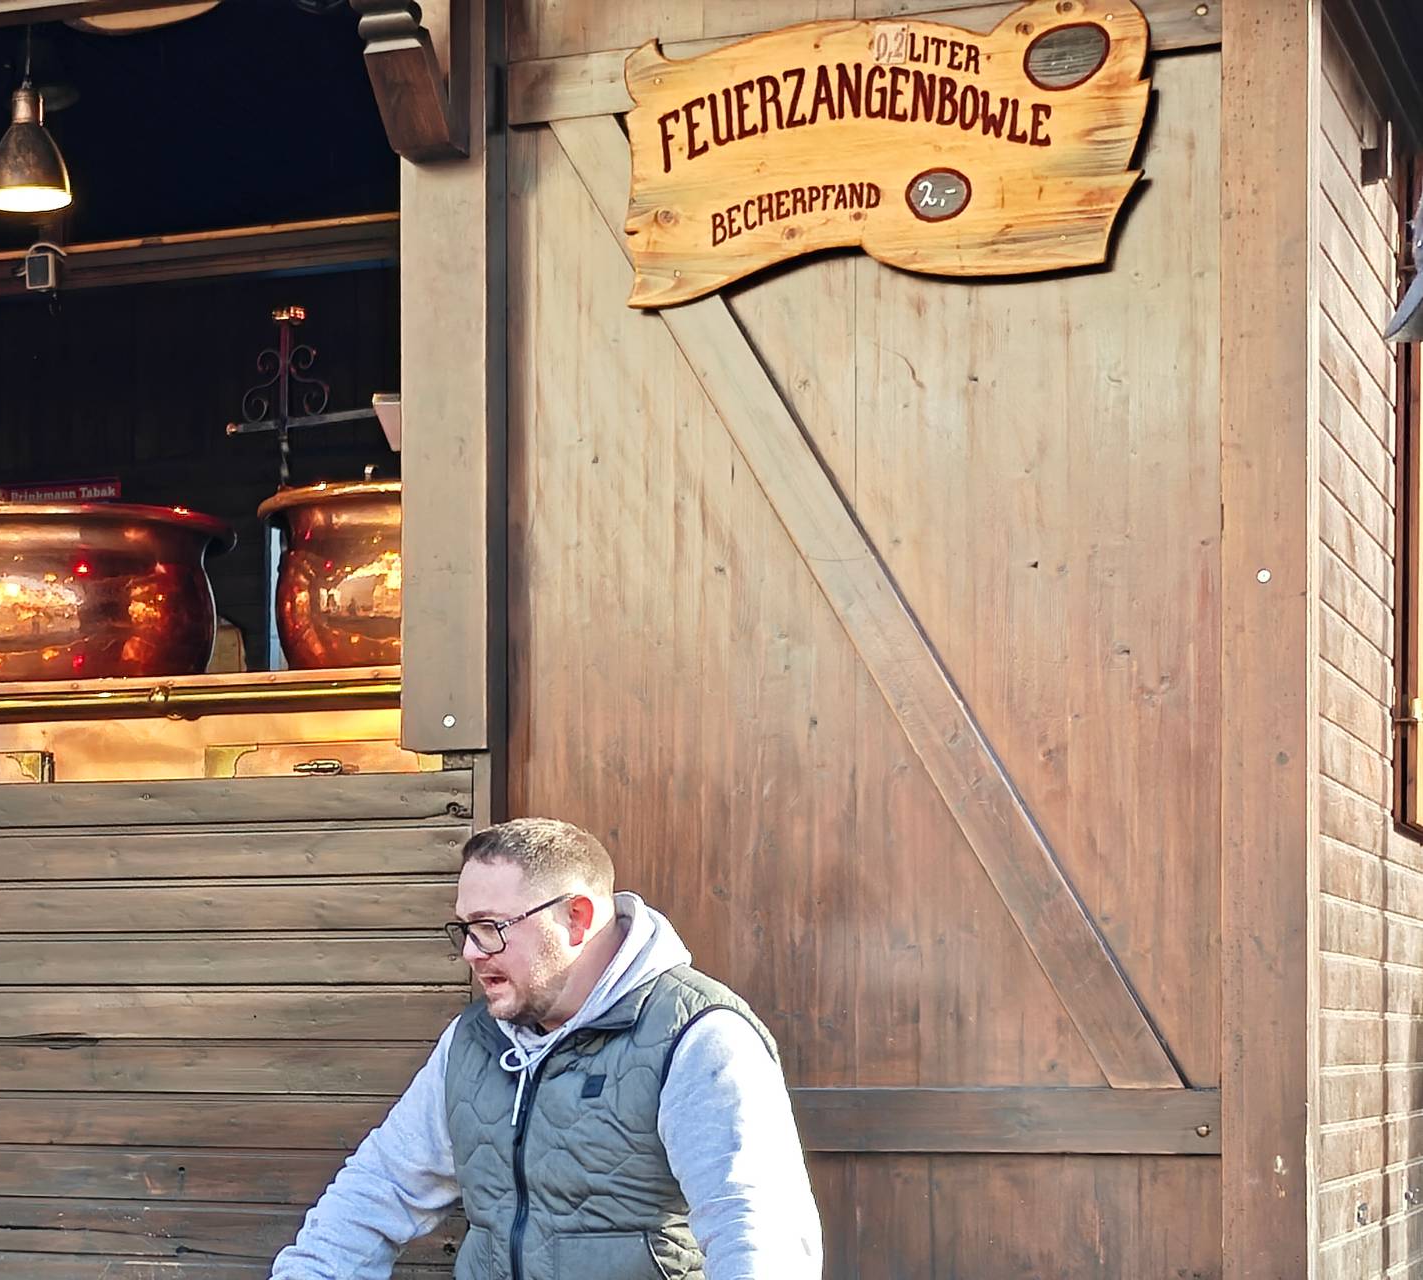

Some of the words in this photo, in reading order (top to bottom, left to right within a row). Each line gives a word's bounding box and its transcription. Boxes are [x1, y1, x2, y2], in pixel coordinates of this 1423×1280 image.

[909, 32, 980, 75] LITER
[657, 62, 1052, 173] FEUERZANGENBOWLE
[711, 182, 881, 247] BECHERPFAND
[79, 486, 116, 498] Tabak
